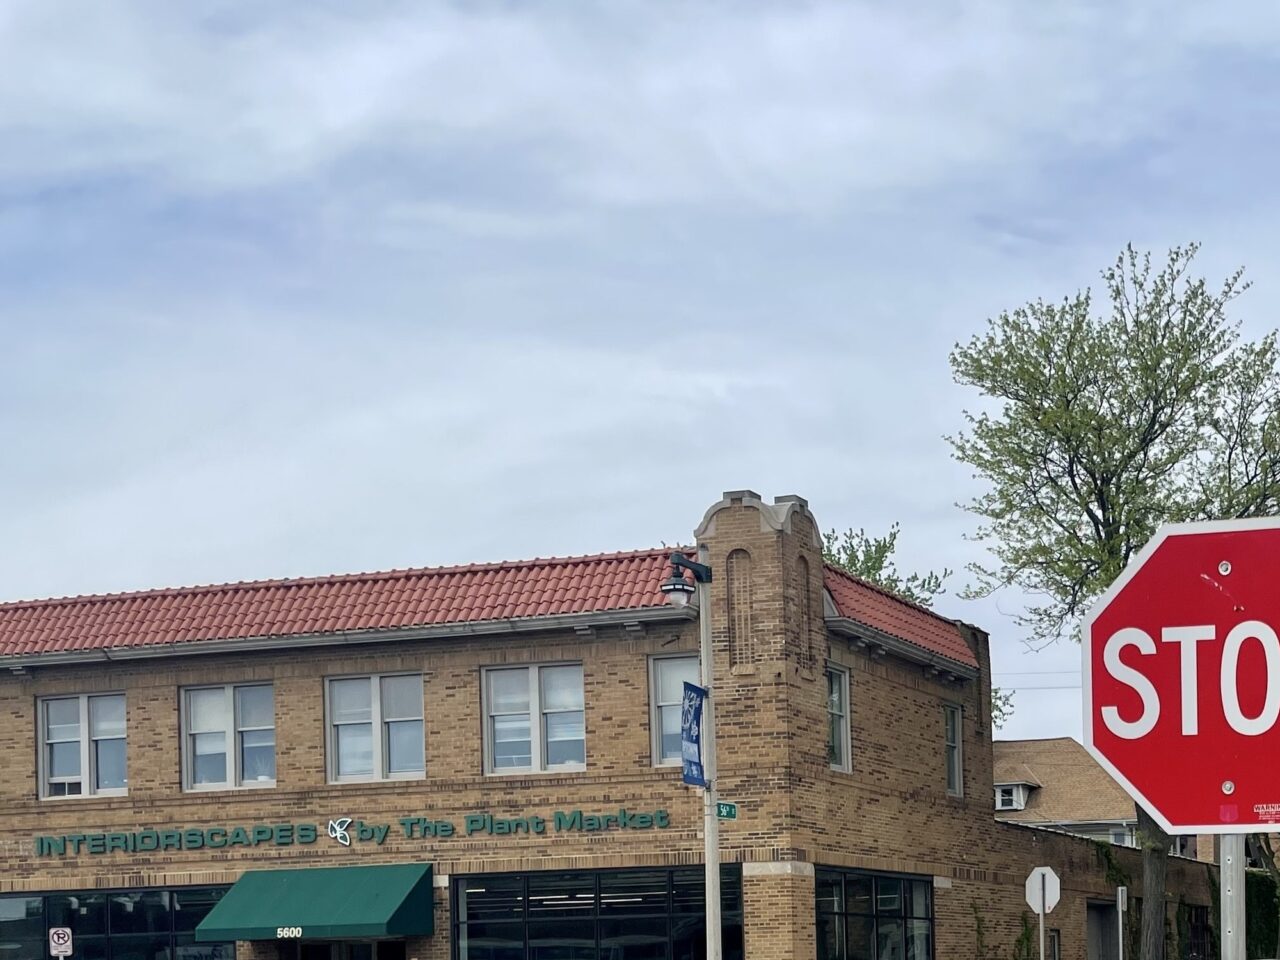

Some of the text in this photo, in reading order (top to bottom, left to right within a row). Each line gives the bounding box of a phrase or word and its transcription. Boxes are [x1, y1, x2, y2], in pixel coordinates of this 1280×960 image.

[35, 809, 670, 857] INTERIORSCAPES by The Plant Market
[276, 927, 302, 938] 5600
